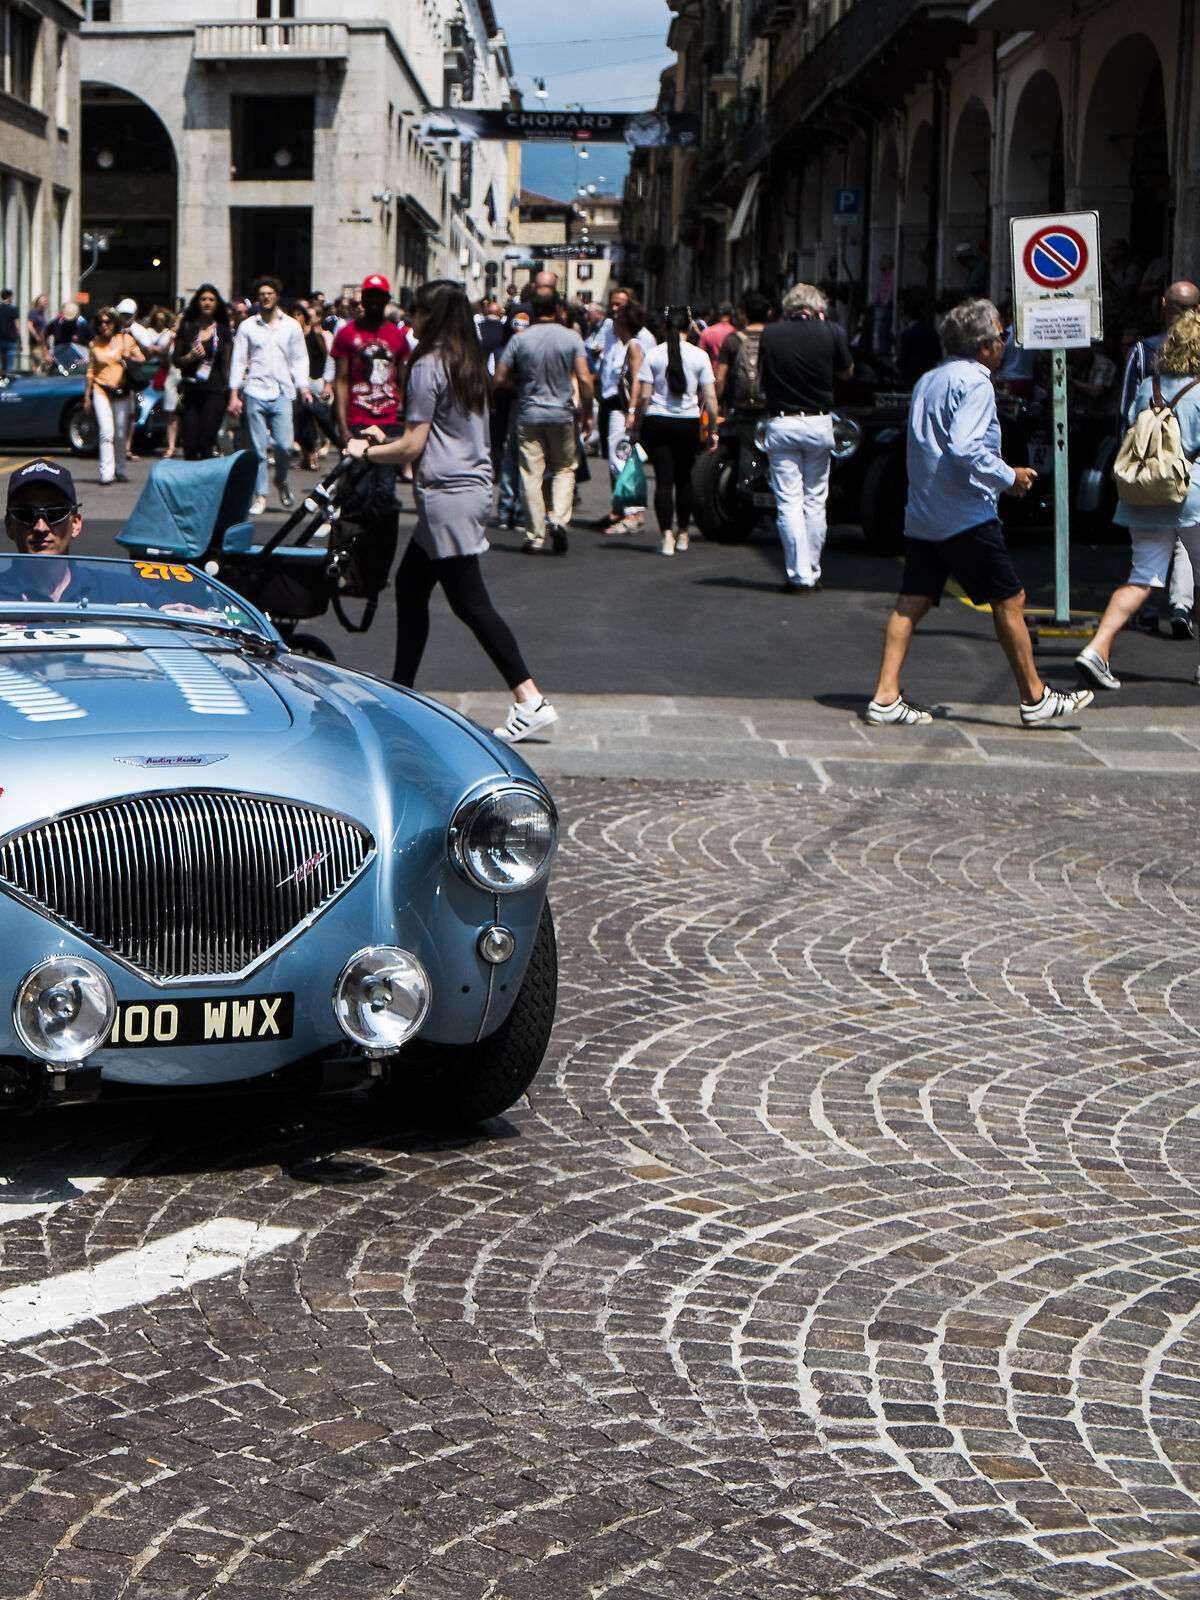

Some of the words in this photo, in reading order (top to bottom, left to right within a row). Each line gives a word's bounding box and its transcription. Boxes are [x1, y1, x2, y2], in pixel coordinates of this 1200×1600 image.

[505, 112, 612, 129] CHOPARD
[840, 191, 855, 211] P
[134, 562, 194, 583] 275
[204, 998, 282, 1039] WWX
